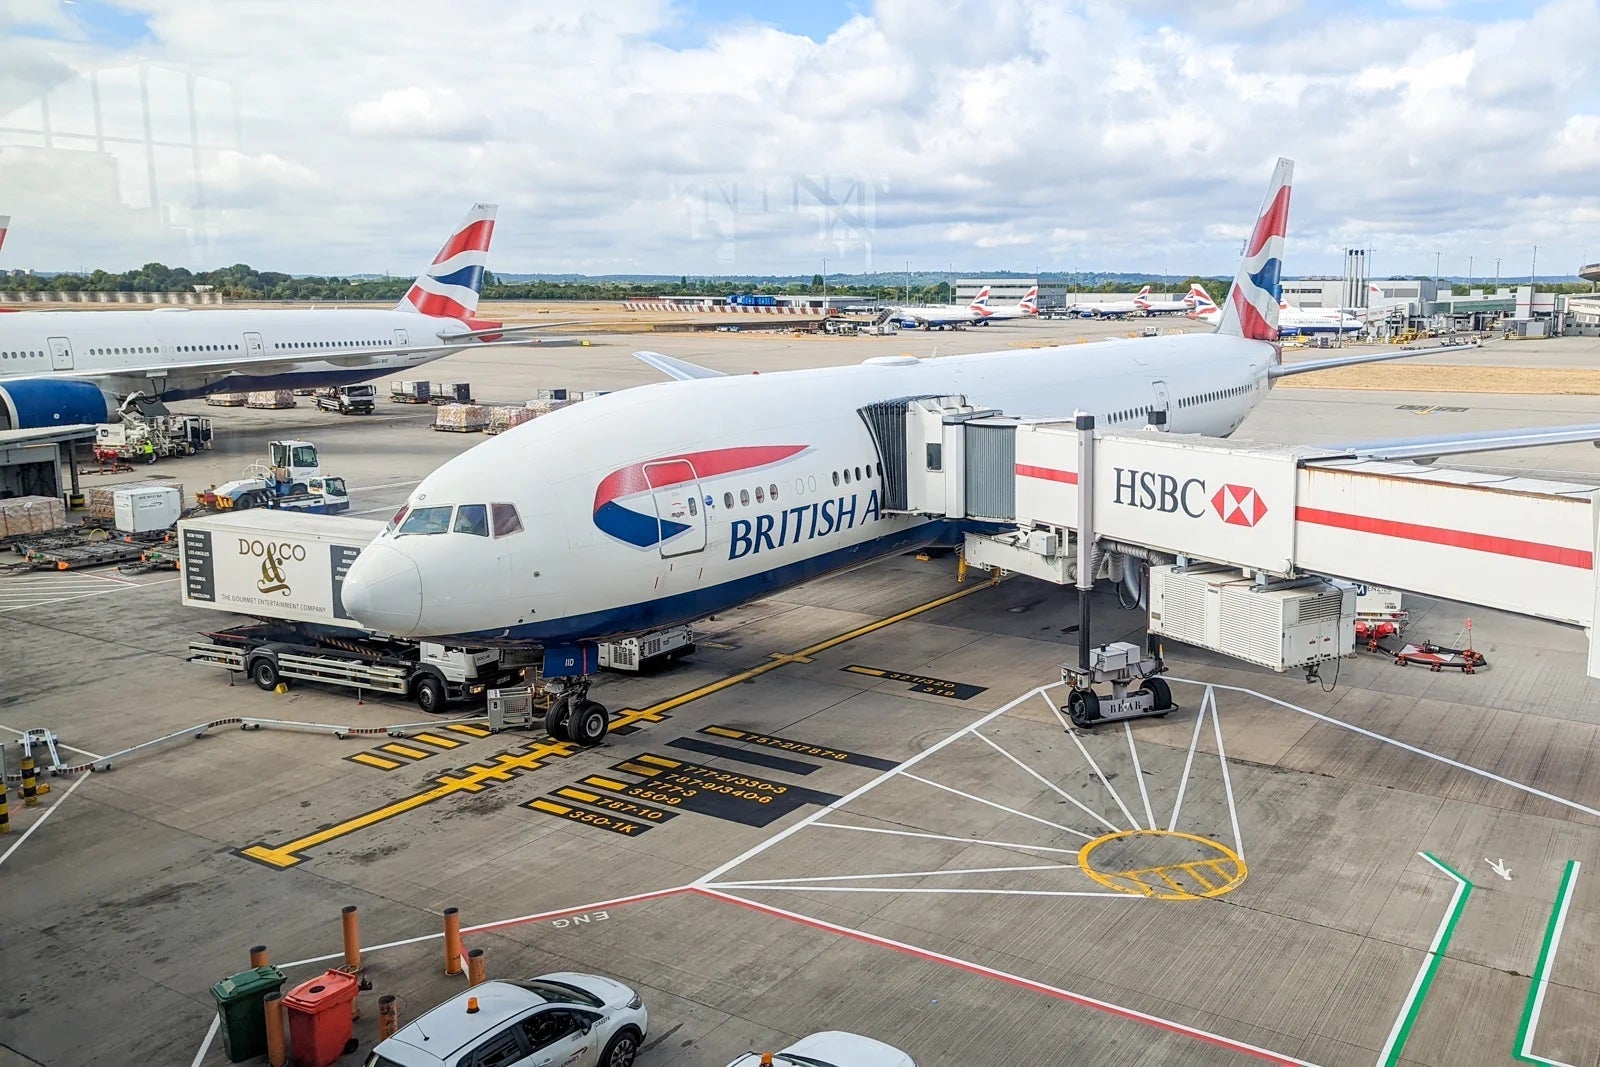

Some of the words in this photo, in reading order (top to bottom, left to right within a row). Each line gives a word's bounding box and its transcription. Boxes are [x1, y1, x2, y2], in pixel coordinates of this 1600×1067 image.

[1113, 467, 1206, 519] HSBC
[728, 493, 858, 560] BRITISH
[231, 595, 257, 604] GOURMET
[257, 599, 300, 610] ENTERTAINMENT
[299, 603, 327, 613] COMPANY
[551, 910, 610, 928] ENG
